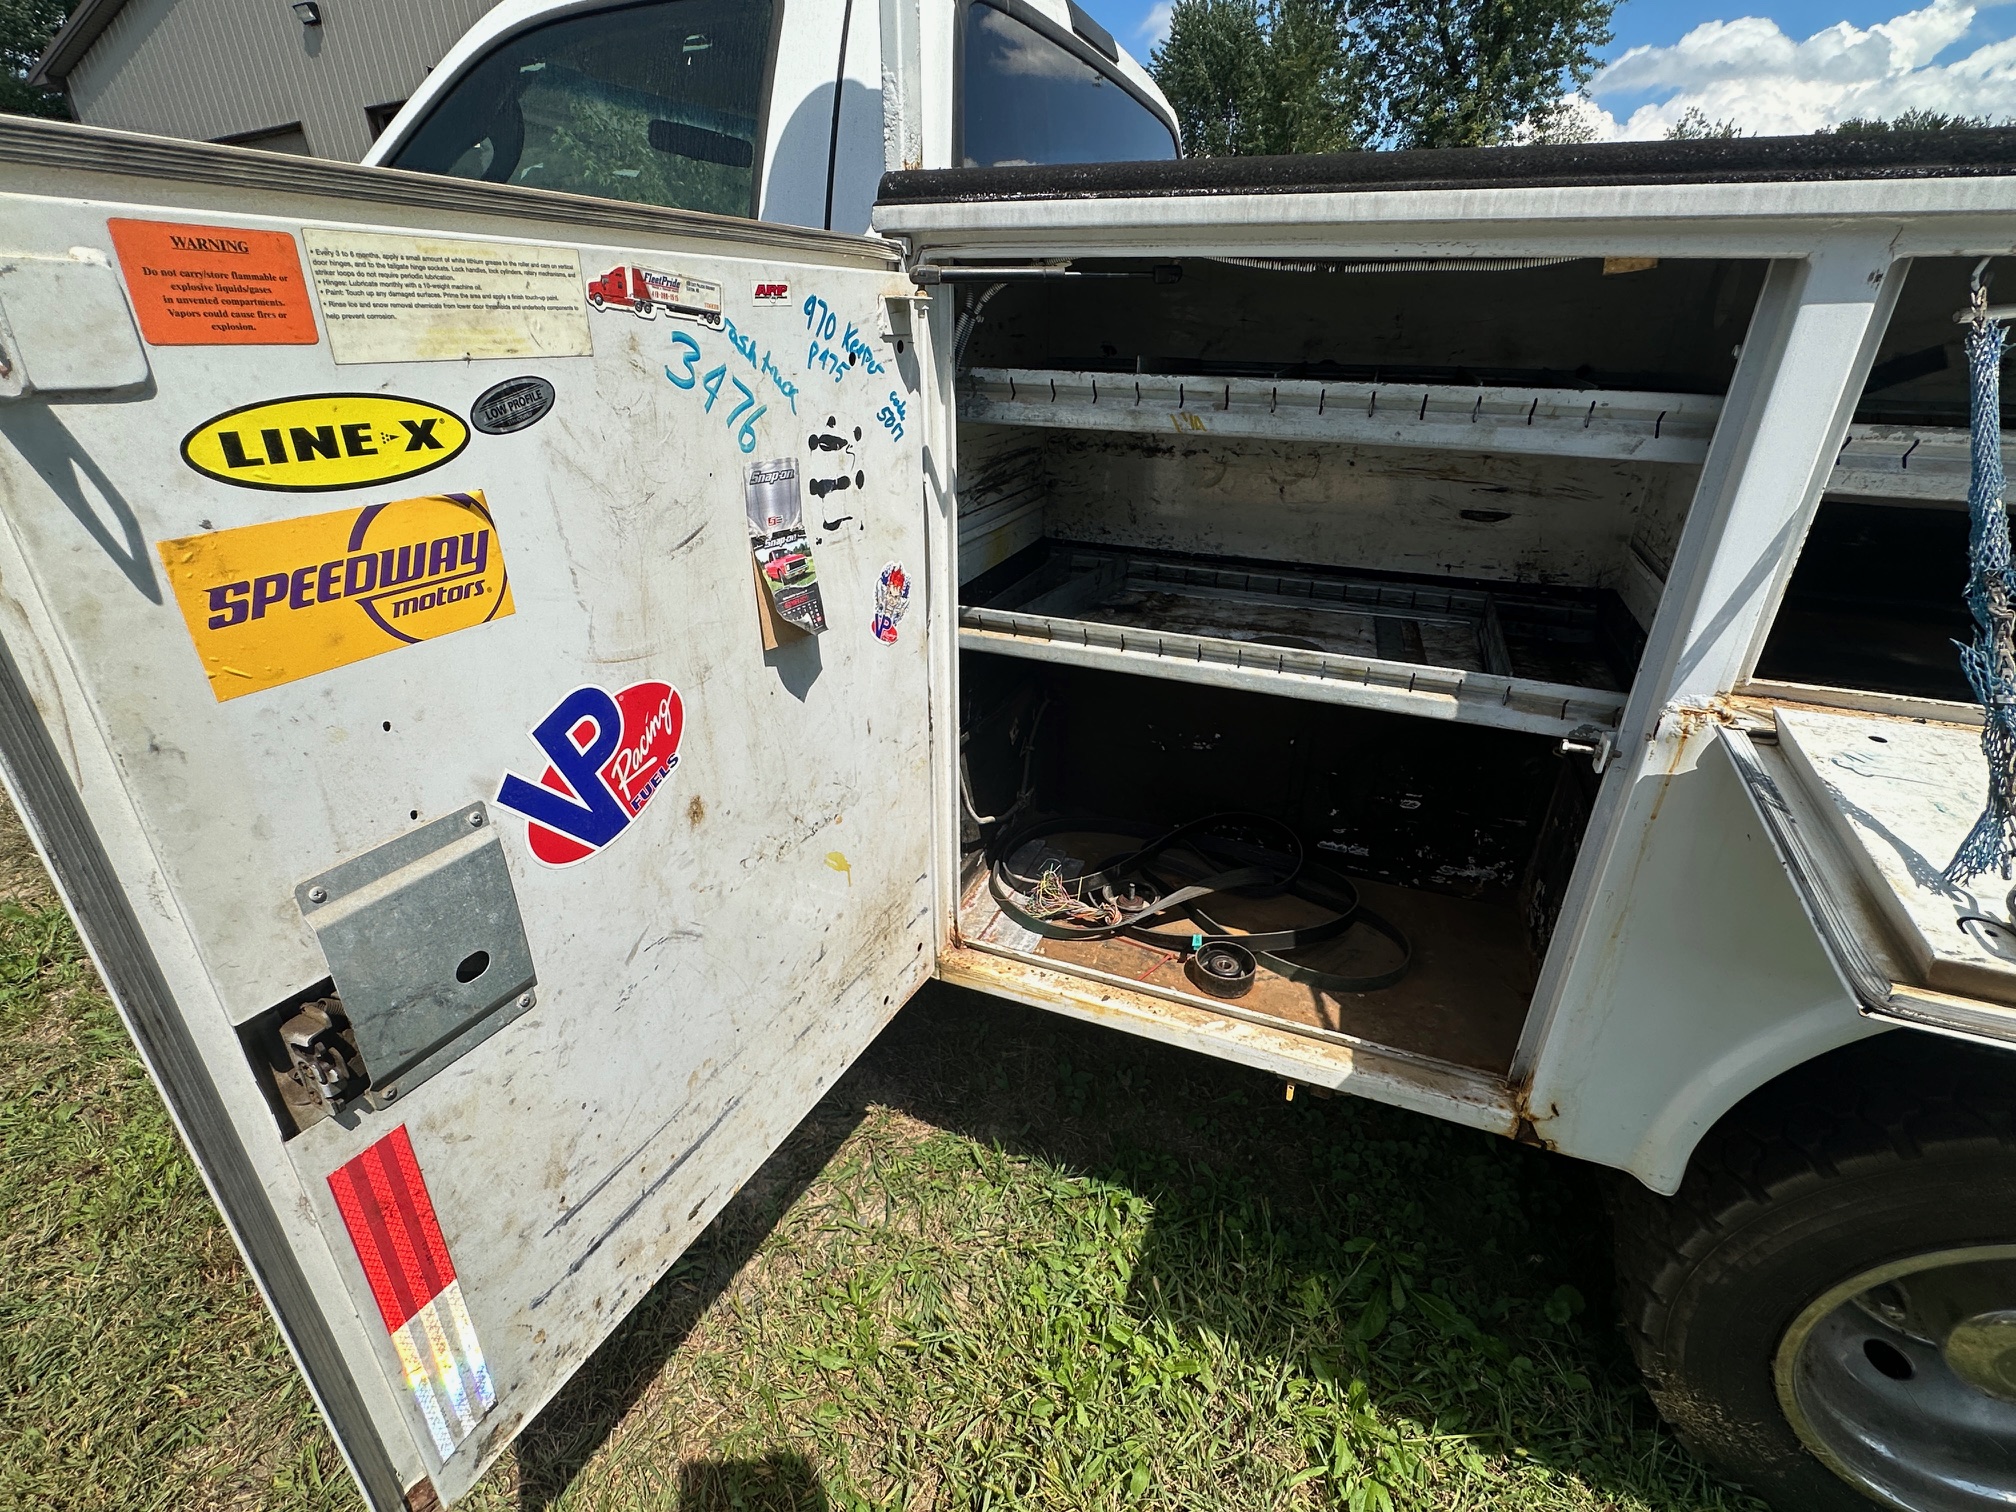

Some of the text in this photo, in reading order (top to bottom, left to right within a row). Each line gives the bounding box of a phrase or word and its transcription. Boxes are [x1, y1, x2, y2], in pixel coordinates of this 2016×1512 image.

[169, 235, 249, 253] WARNING
[315, 249, 334, 257] Every
[382, 253, 398, 261] apply
[142, 266, 158, 276] Do
[161, 268, 176, 277] not
[179, 270, 229, 280] carry/store
[231, 271, 277, 282] flammable
[387, 262, 409, 270] tailgate
[410, 263, 426, 271] hinge
[170, 283, 272, 294] explosive liquids/gases
[379, 281, 403, 289] monthly
[644, 272, 681, 289] FleetPride
[755, 284, 788, 296] ARP
[163, 295, 286, 308] in unvented compartments.
[167, 308, 287, 319] Vapors could cause fires or
[325, 312, 340, 320] help
[211, 322, 256, 332] explosion.
[664, 330, 768, 453] 3476
[485, 403, 508, 421] LOW
[508, 389, 543, 412] PROFILE
[750, 468, 795, 485] Snap-on
[764, 534, 798, 549] Snap-on
[202, 529, 490, 631] SPEEDWAY
[391, 579, 486, 619] motors
[875, 613, 892, 640] VP
[611, 687, 675, 801] Racing
[496, 687, 631, 848] VP
[630, 753, 679, 811] FUELS
